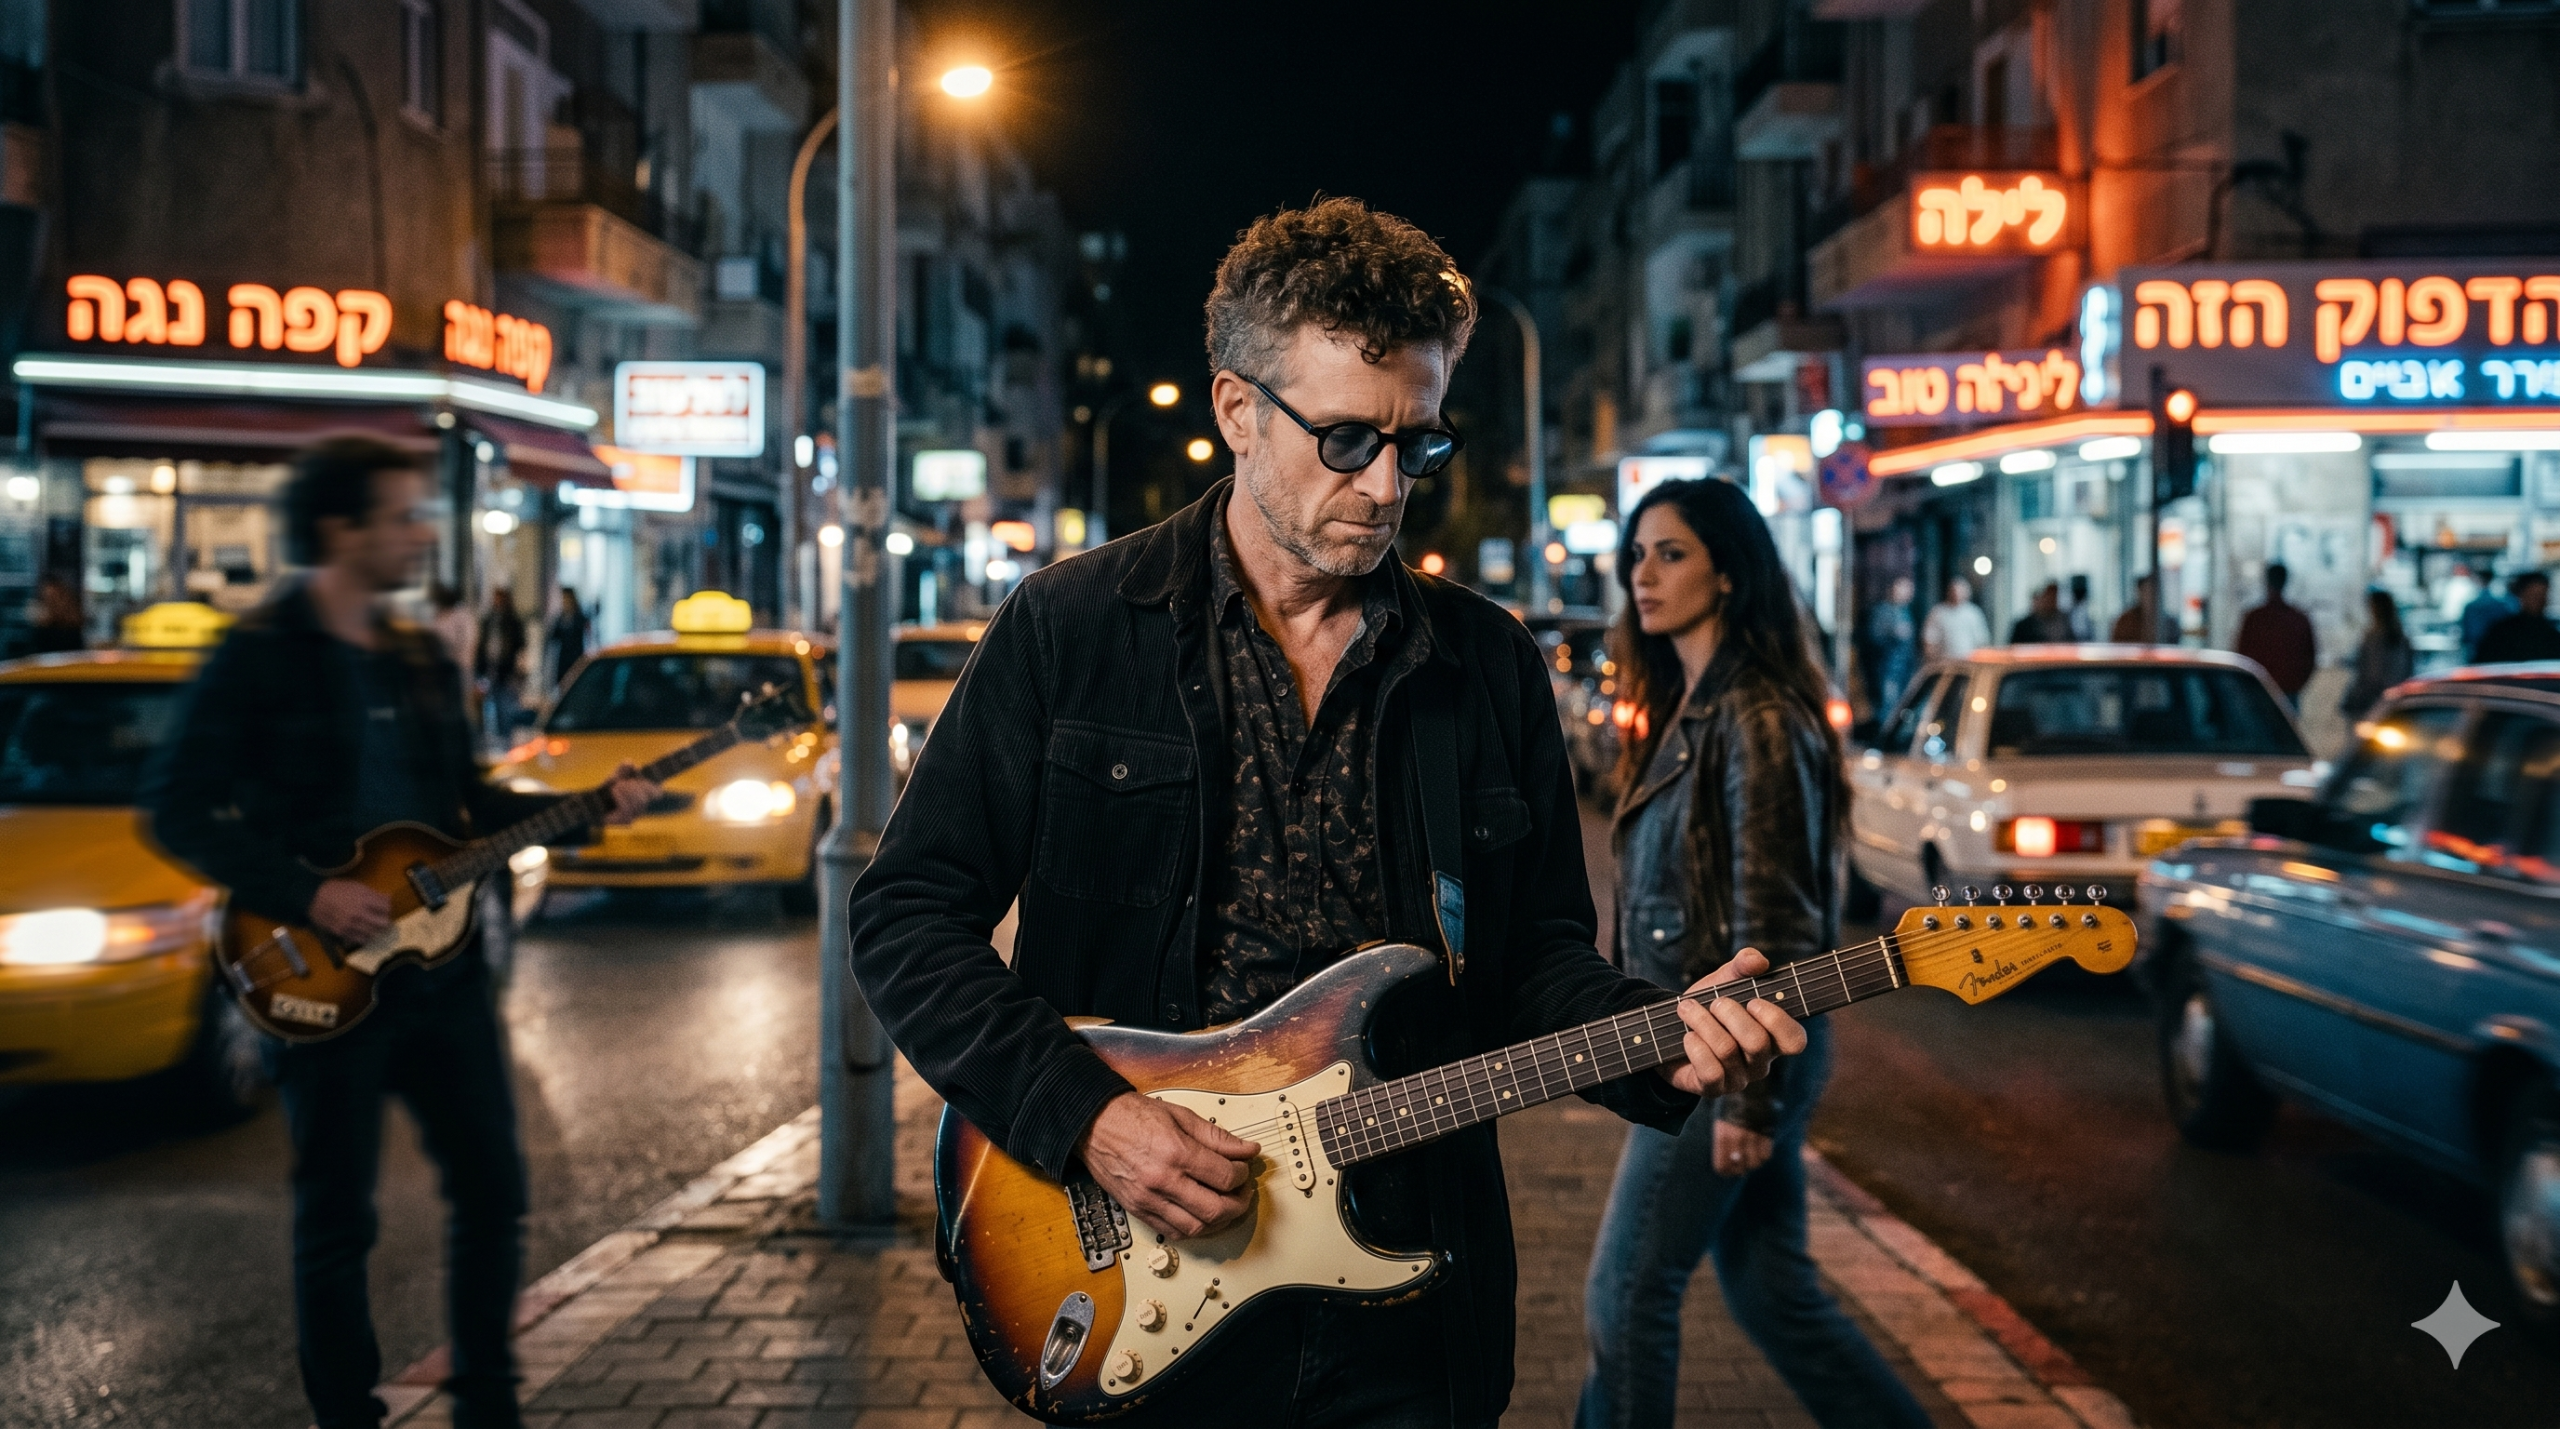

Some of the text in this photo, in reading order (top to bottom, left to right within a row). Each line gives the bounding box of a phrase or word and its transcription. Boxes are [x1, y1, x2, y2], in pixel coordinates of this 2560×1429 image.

[1918, 175, 2066, 245] לילה
[67, 275, 393, 368] קפה נגה
[2134, 278, 2288, 349] הזה
[2315, 276, 2560, 364] הדפוק
[1867, 366, 1950, 417] טוב
